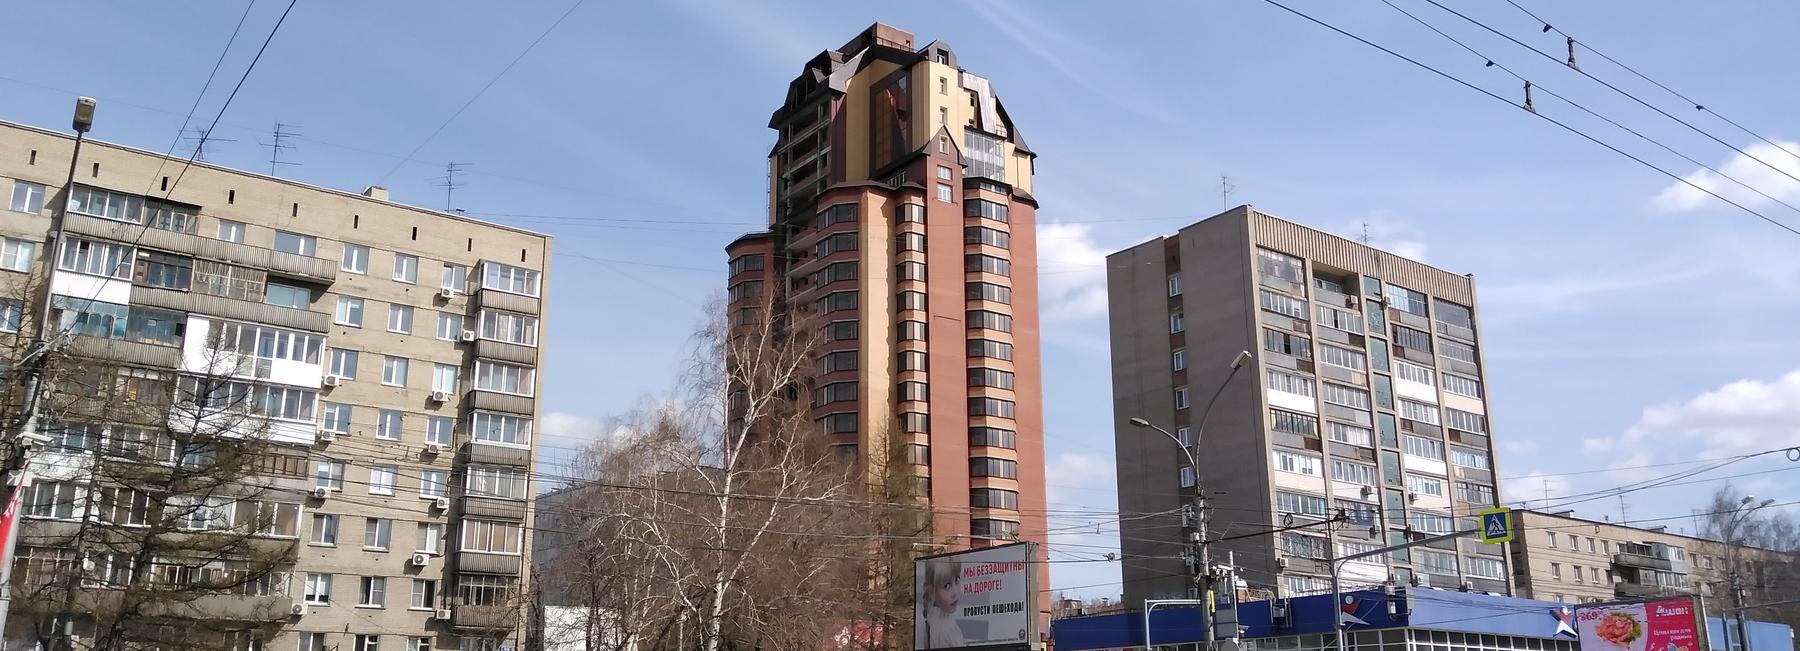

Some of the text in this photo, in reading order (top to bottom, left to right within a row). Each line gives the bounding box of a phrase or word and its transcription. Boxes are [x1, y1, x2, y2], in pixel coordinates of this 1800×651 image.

[963, 560, 1025, 578] МЫ БЕЗЗАЩИТНЫ
[963, 580, 1002, 594] НА ДОРОГЕ!
[963, 601, 1024, 617] ПРОПУСТИ ПЕШЕХОДА!
